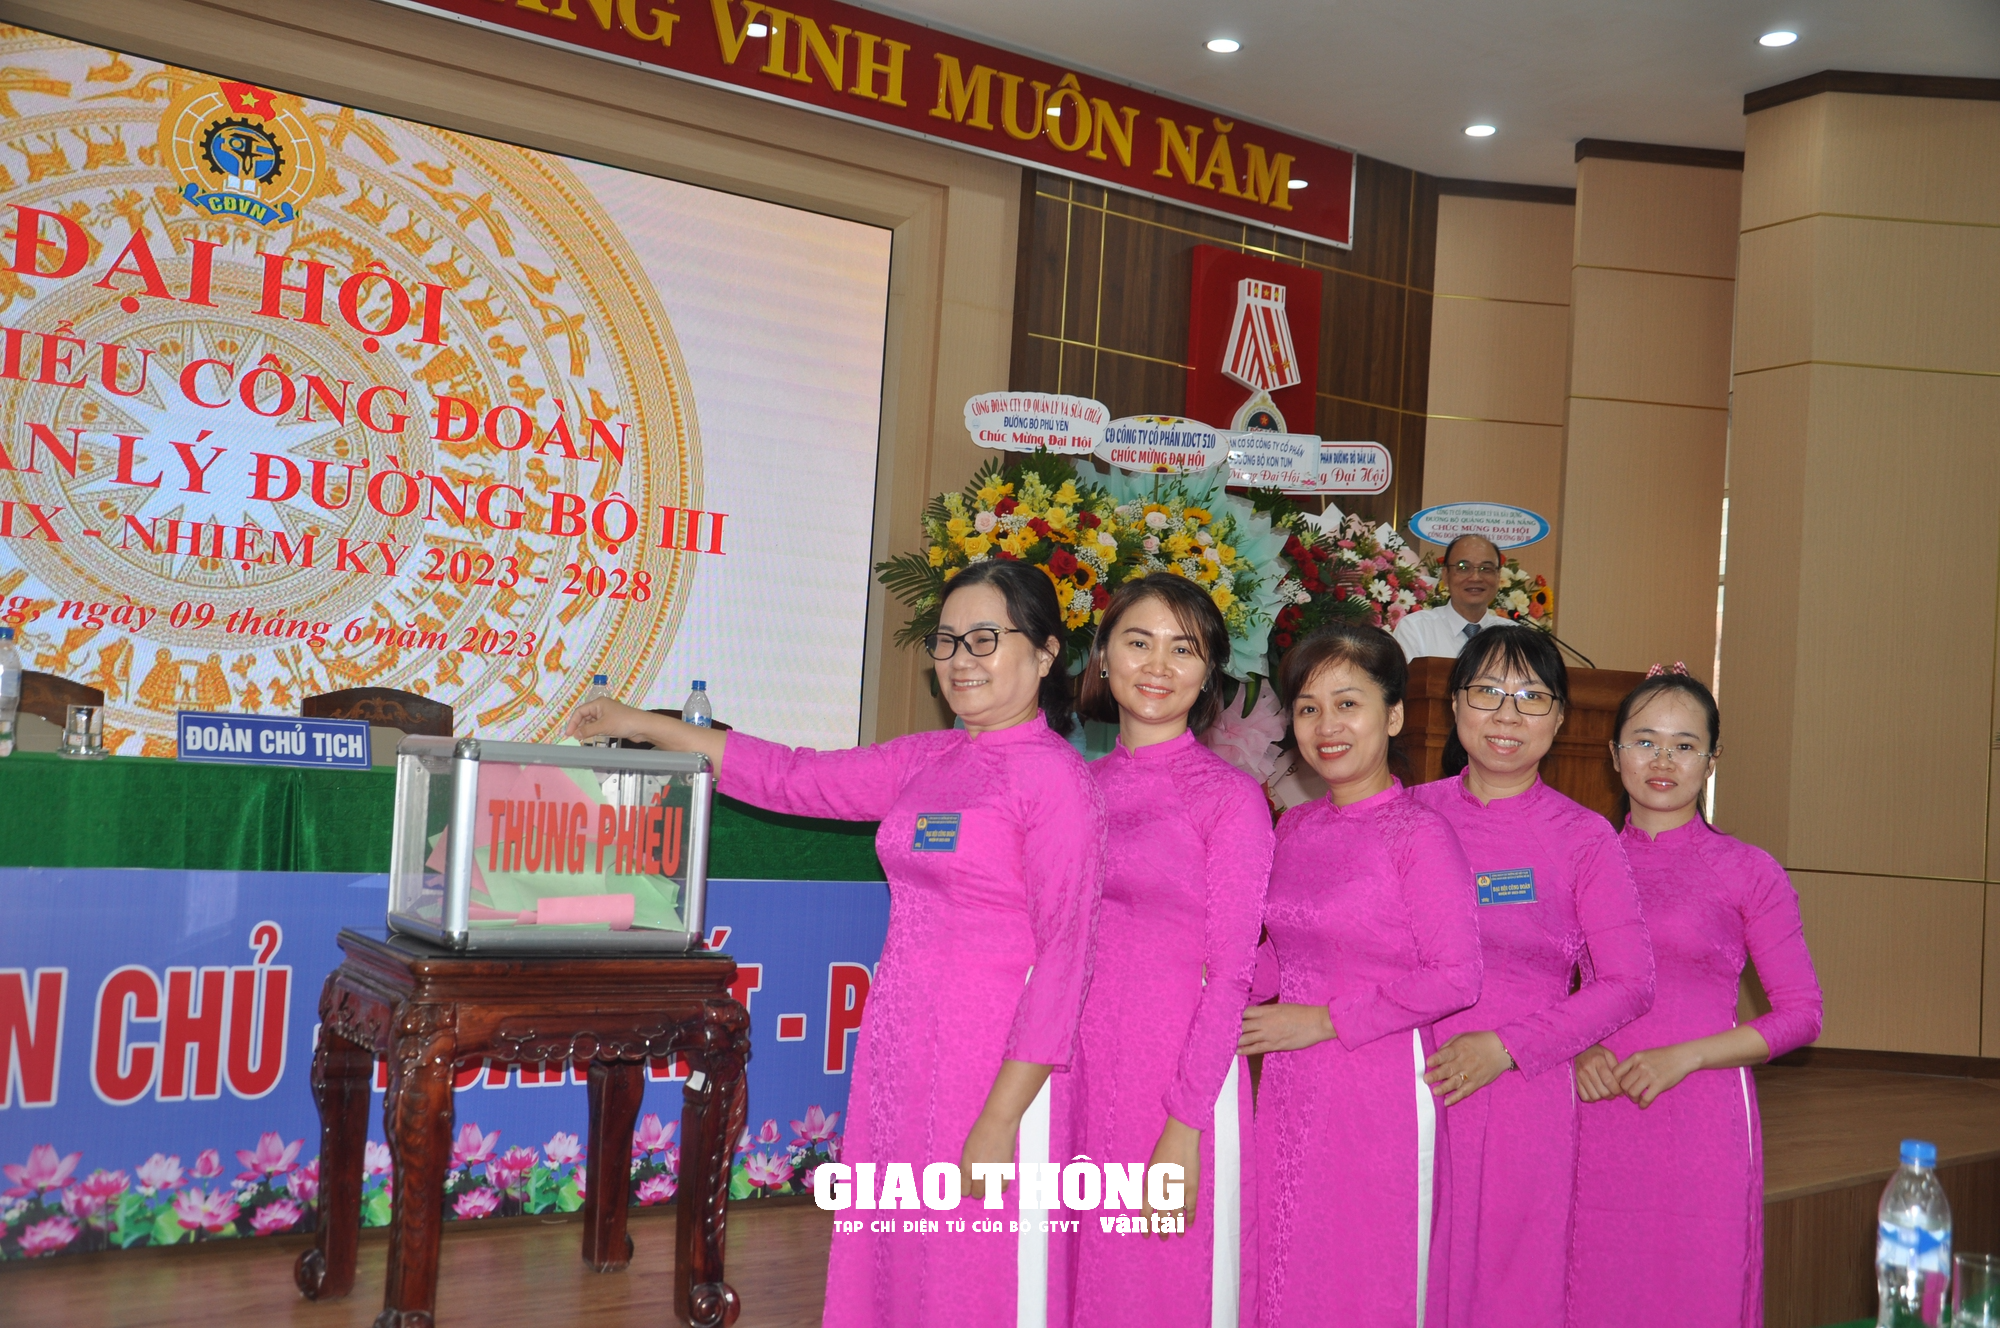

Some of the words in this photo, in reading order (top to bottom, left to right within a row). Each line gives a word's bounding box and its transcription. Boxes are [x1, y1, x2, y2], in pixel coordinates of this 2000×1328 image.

[710, 0, 911, 107] VINH
[929, 53, 1140, 168] MUÔN
[1153, 117, 1296, 211] NĂM
[207, 196, 267, 220] CĐVN
[3, 203, 223, 314] ĐẠI
[251, 251, 452, 354] HỘI
[179, 353, 411, 434] CÔNG
[430, 397, 631, 466] ĐOÀN
[971, 399, 990, 416] CÔNG
[990, 394, 1008, 412] ĐOÀN
[1010, 398, 1021, 412] CTY
[1023, 398, 1032, 412] CP
[1033, 395, 1049, 414] QUẢN
[1050, 397, 1060, 415] LÝ
[1004, 414, 1028, 429] ĐƯỜNG
[1029, 417, 1039, 431] BỘ
[1040, 418, 1054, 431] PHÚ
[1055, 418, 1069, 432] YÊN
[979, 429, 1007, 442] Chúc
[1012, 431, 1045, 448] Mừng
[1048, 434, 1067, 449] Đại
[1071, 436, 1092, 451] Hội
[1105, 428, 1115, 443] CĐ
[1116, 424, 1137, 444] CÔNG
[1138, 429, 1148, 445] TY
[1181, 431, 1202, 448] XDCT
[1202, 433, 1216, 449] 510
[1255, 437, 1271, 449] CÔNG
[1273, 441, 1279, 450] TY
[1111, 446, 1137, 463] CHÚC
[1138, 447, 1167, 465] MỪNG
[1169, 452, 1186, 468] ĐẠI
[1187, 450, 1205, 470] HỘI
[1257, 453, 1265, 468] BỘ
[1266, 456, 1279, 467] KON
[1281, 456, 1293, 468] TUM
[1260, 470, 1279, 483] Đại
[1281, 470, 1300, 484] Hội
[1331, 467, 1356, 486] Đại
[1361, 467, 1385, 486] Hội
[109, 430, 227, 494] LÝ
[247, 453, 527, 531] ĐƯỜNG
[549, 491, 639, 555] BỘ
[656, 506, 729, 555] III
[1432, 523, 1459, 532] CHÚC
[1461, 523, 1489, 532] MỪNG
[1492, 526, 1510, 535] ĐẠI
[1512, 526, 1529, 535] HỘI
[121, 514, 318, 571] NHIỆM
[332, 534, 410, 577] KỲ
[424, 549, 521, 589] 2023
[562, 563, 653, 602] 2028
[57, 595, 156, 633] ngày
[169, 600, 215, 629] 09
[225, 608, 332, 648] tháng
[343, 616, 363, 644] 6
[373, 621, 448, 650] năm
[458, 627, 538, 657] 2023
[186, 722, 252, 753] ĐOÀN
[260, 724, 306, 756] CHỦ
[312, 733, 363, 762] TỊCH
[489, 783, 588, 874] THÙNG
[595, 785, 683, 877] PHIẾU
[92, 921, 292, 1105] CHỦ
